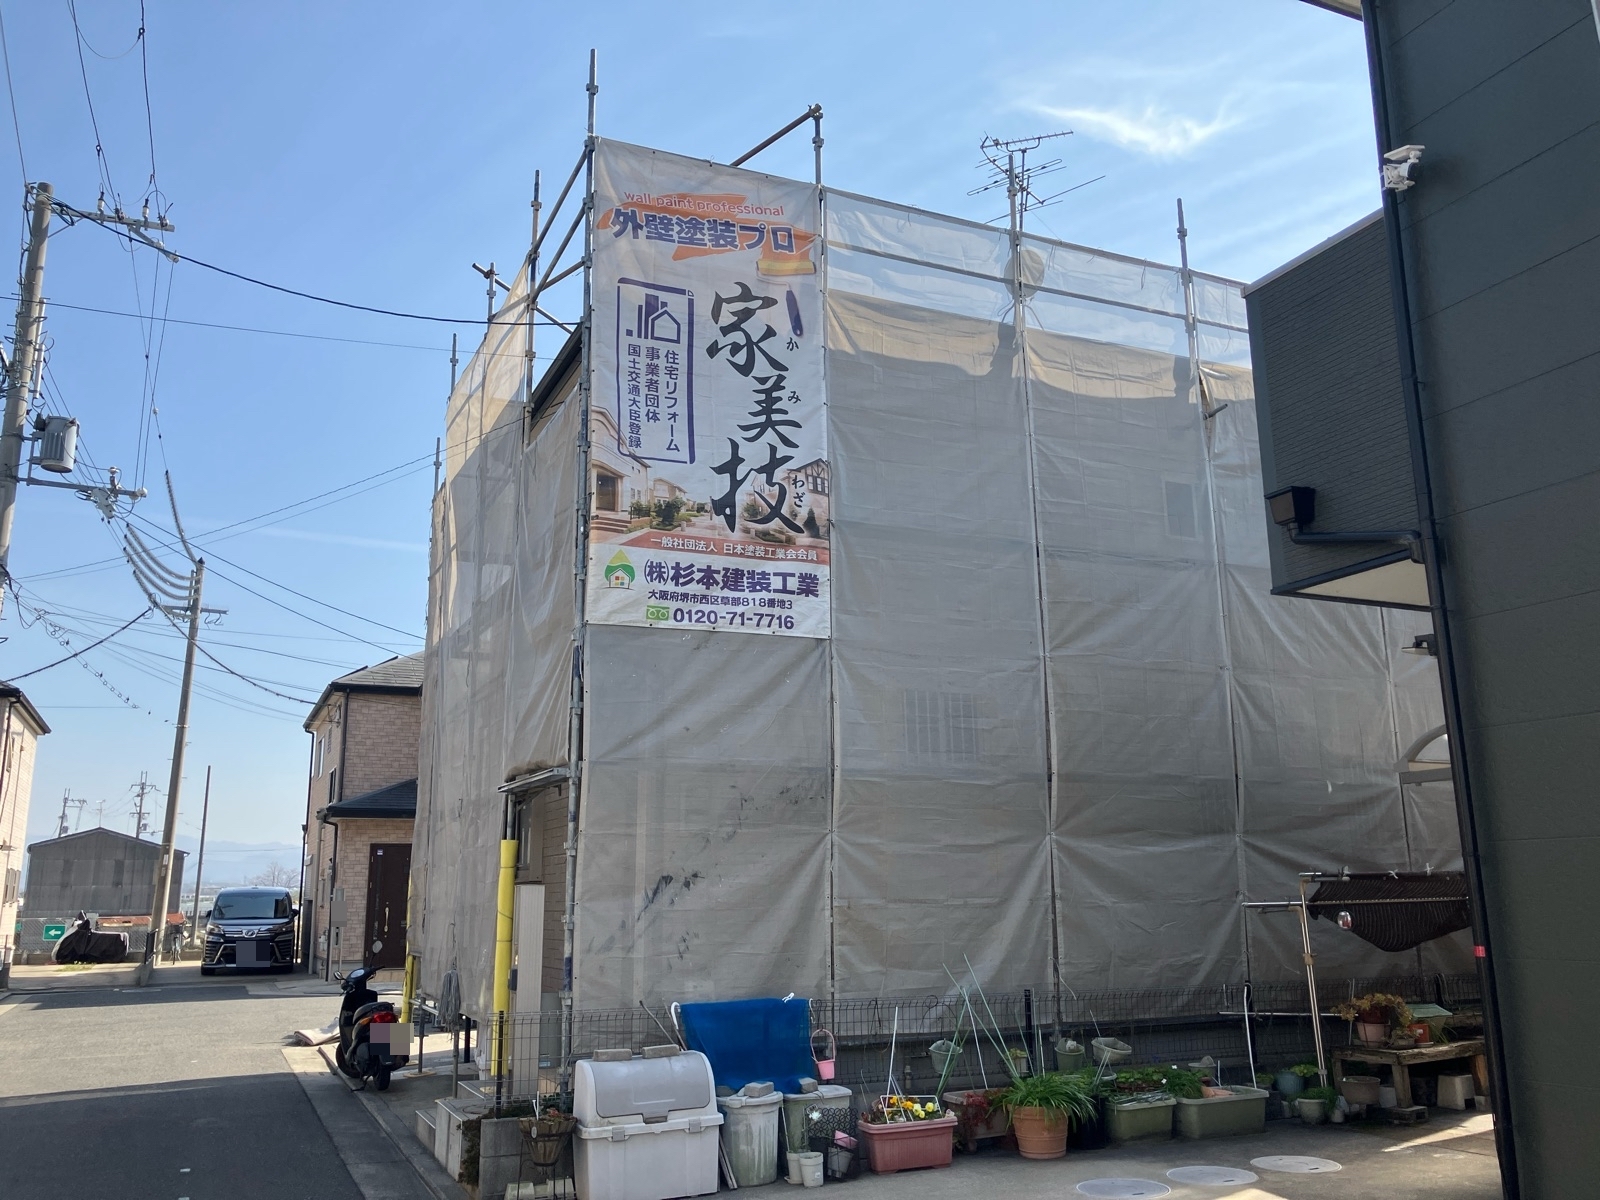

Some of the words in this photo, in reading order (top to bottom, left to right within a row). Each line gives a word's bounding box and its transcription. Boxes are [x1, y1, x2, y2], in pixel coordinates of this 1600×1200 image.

[624, 191, 652, 205] wall
[656, 196, 694, 210] paint
[697, 200, 784, 216] professional
[610, 207, 796, 254] 外壁塗装プロ
[786, 337, 799, 352] か
[627, 343, 642, 449] 国土交通大臣登録
[644, 346, 661, 424] 事業者団体
[787, 390, 802, 404] み
[664, 349, 680, 453] 住宅リフォーム
[705, 281, 805, 534] 家美技
[791, 474, 805, 509] わざ
[650, 536, 718, 553] 一般社団法人
[723, 542, 818, 561] 日本塗装工業会会員
[647, 589, 793, 610] 大阪府堺市西区草部818番地3
[673, 607, 795, 630] 0120-71-7716
